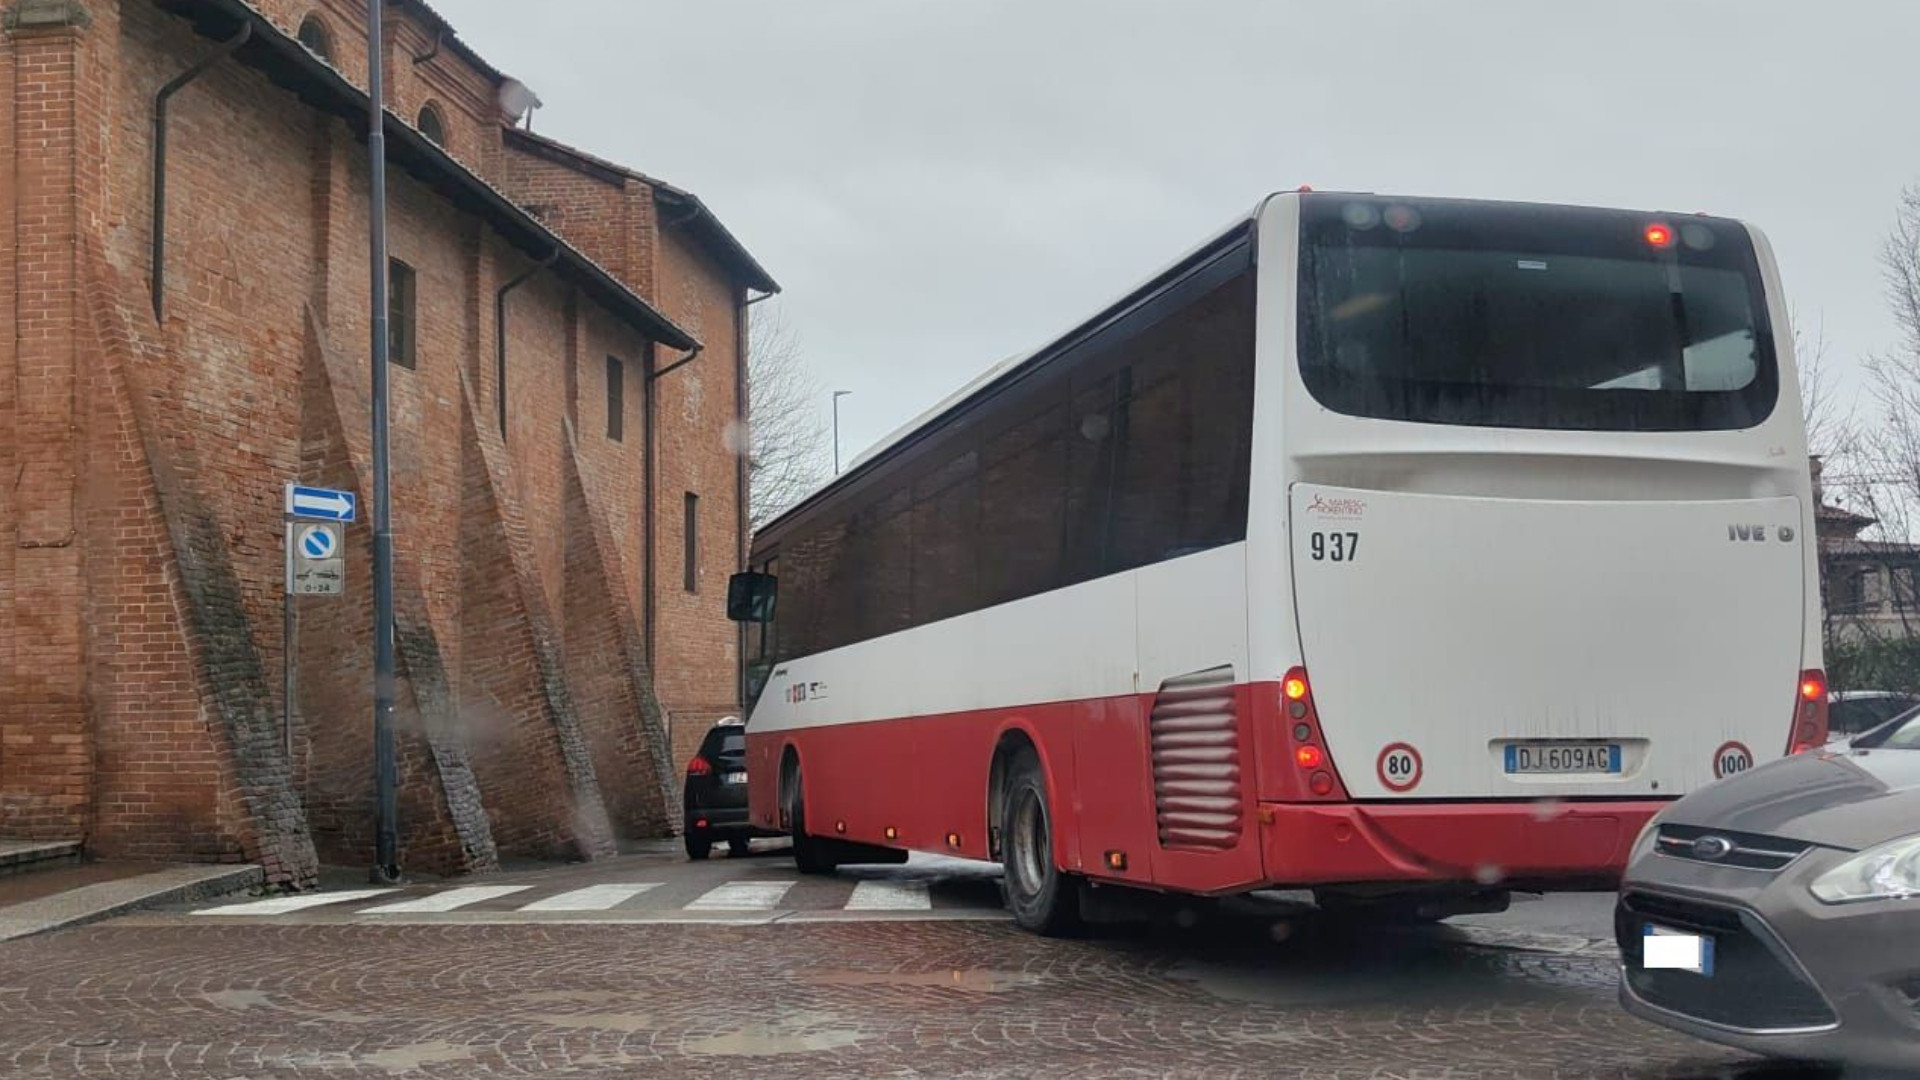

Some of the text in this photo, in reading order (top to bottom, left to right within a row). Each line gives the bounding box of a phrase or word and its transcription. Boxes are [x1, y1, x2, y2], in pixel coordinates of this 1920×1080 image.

[1311, 531, 1359, 561] 937
[1388, 755, 1411, 775] 80
[1721, 754, 1746, 774] 100
